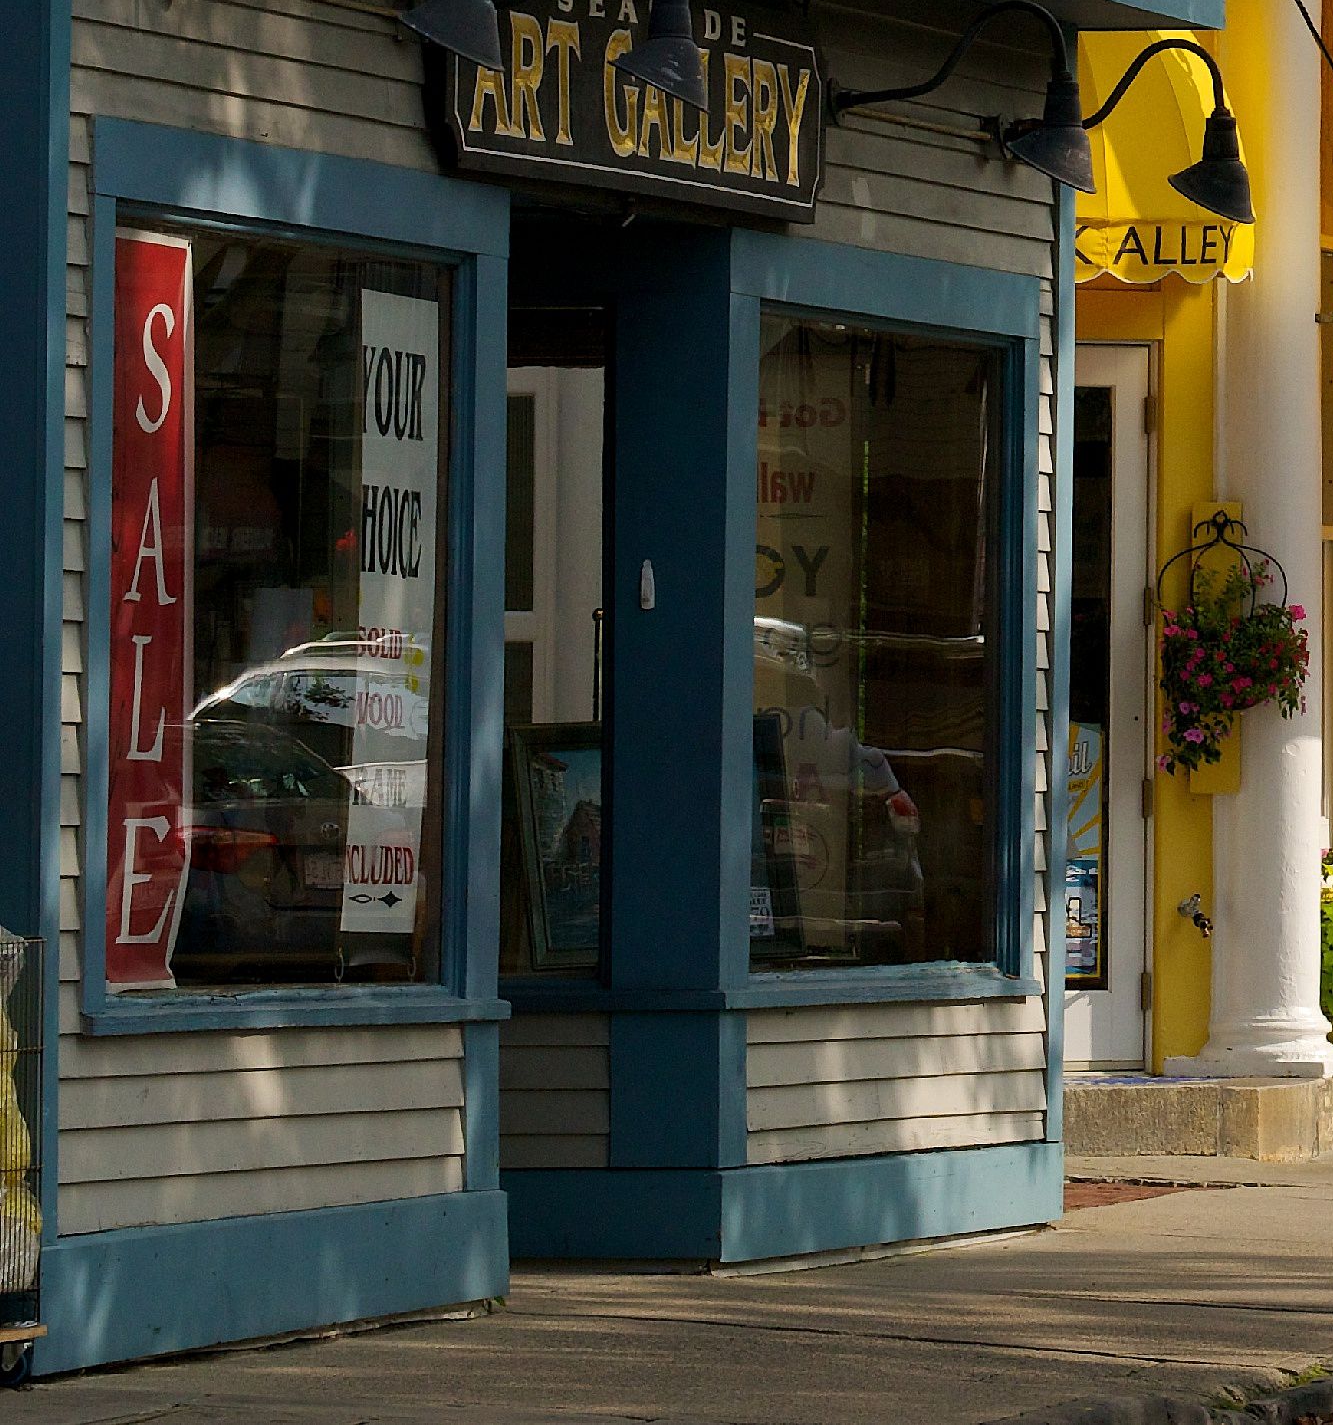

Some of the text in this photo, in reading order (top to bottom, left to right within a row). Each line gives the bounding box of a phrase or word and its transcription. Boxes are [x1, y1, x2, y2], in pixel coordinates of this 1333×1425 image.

[467, 11, 582, 146] ART
[1112, 225, 1235, 266] ALLEY
[362, 484, 422, 579] HOICE
[115, 302, 178, 945] SALE
[358, 625, 403, 660] SOLID
[346, 845, 414, 885] CLUDED
